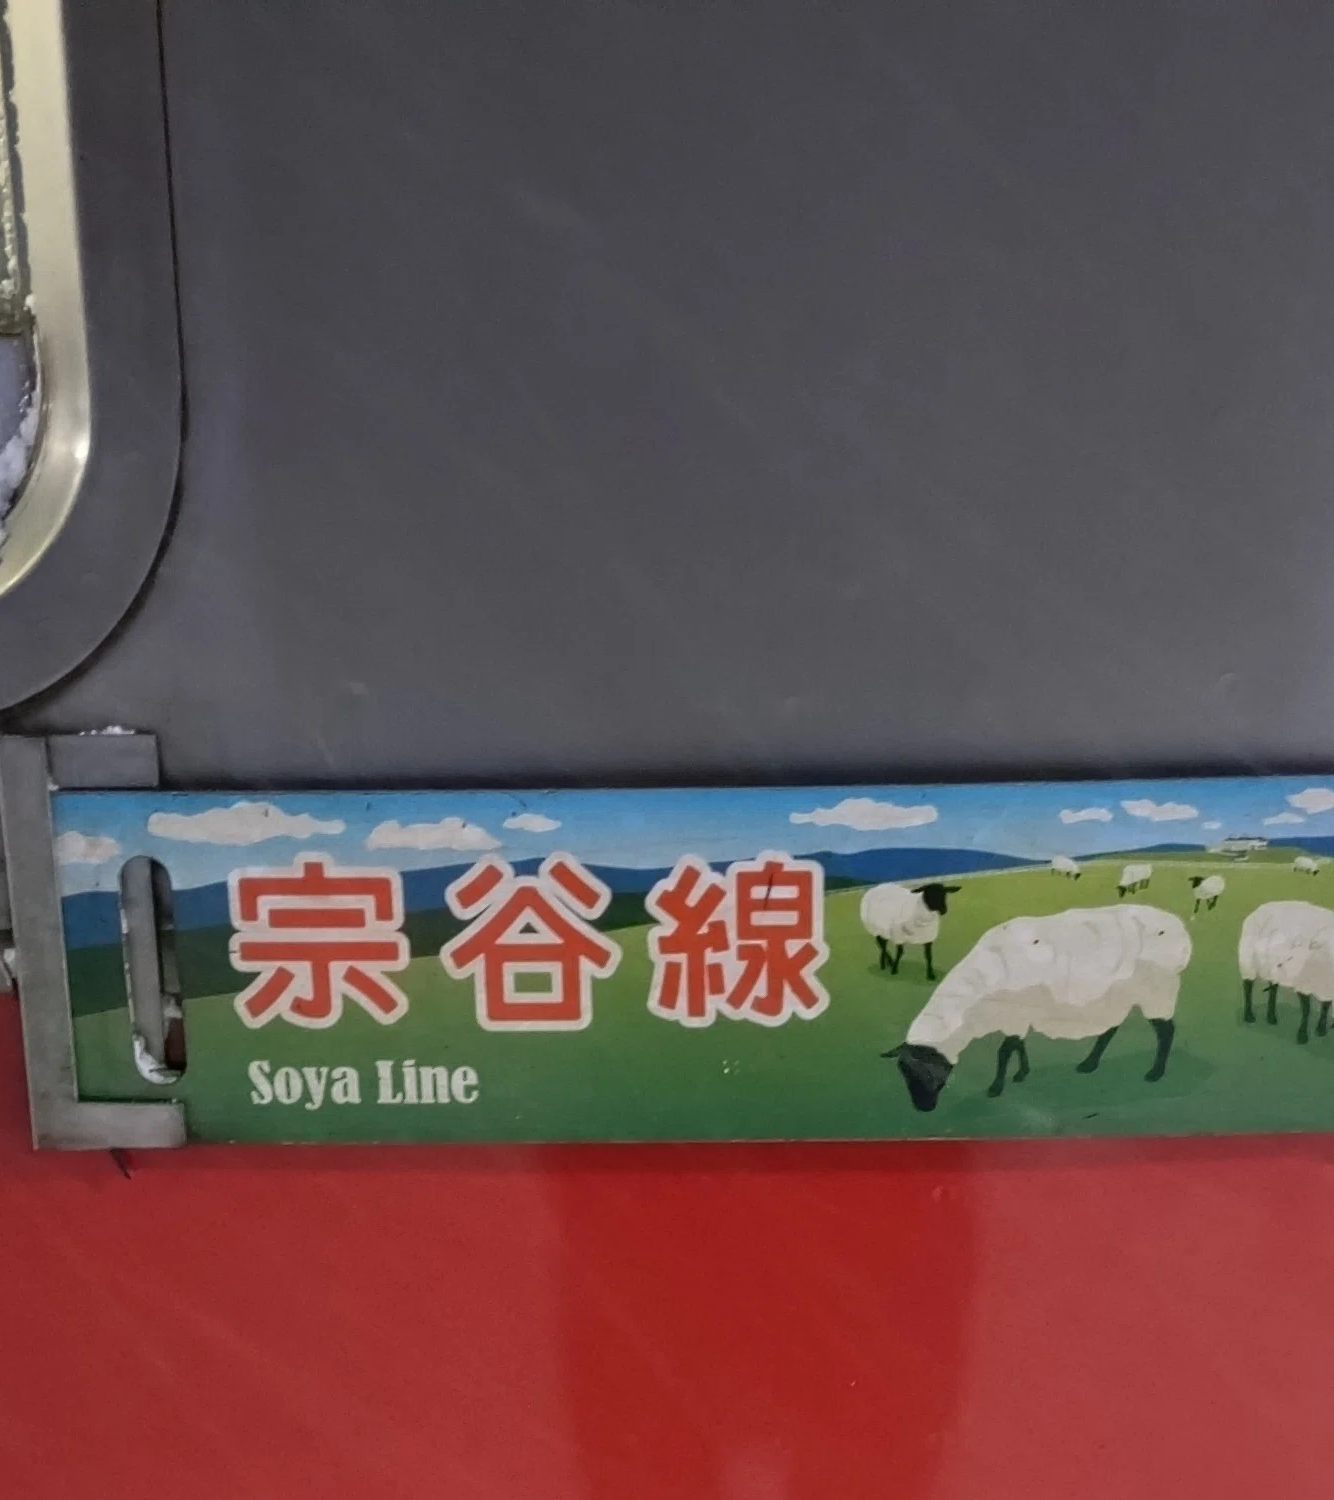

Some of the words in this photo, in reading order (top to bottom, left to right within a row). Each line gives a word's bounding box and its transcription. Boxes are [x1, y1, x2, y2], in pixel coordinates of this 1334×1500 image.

[234, 856, 825, 1027] 宗谷線
[247, 1058, 362, 1110] Soya
[374, 1057, 480, 1106] Line
